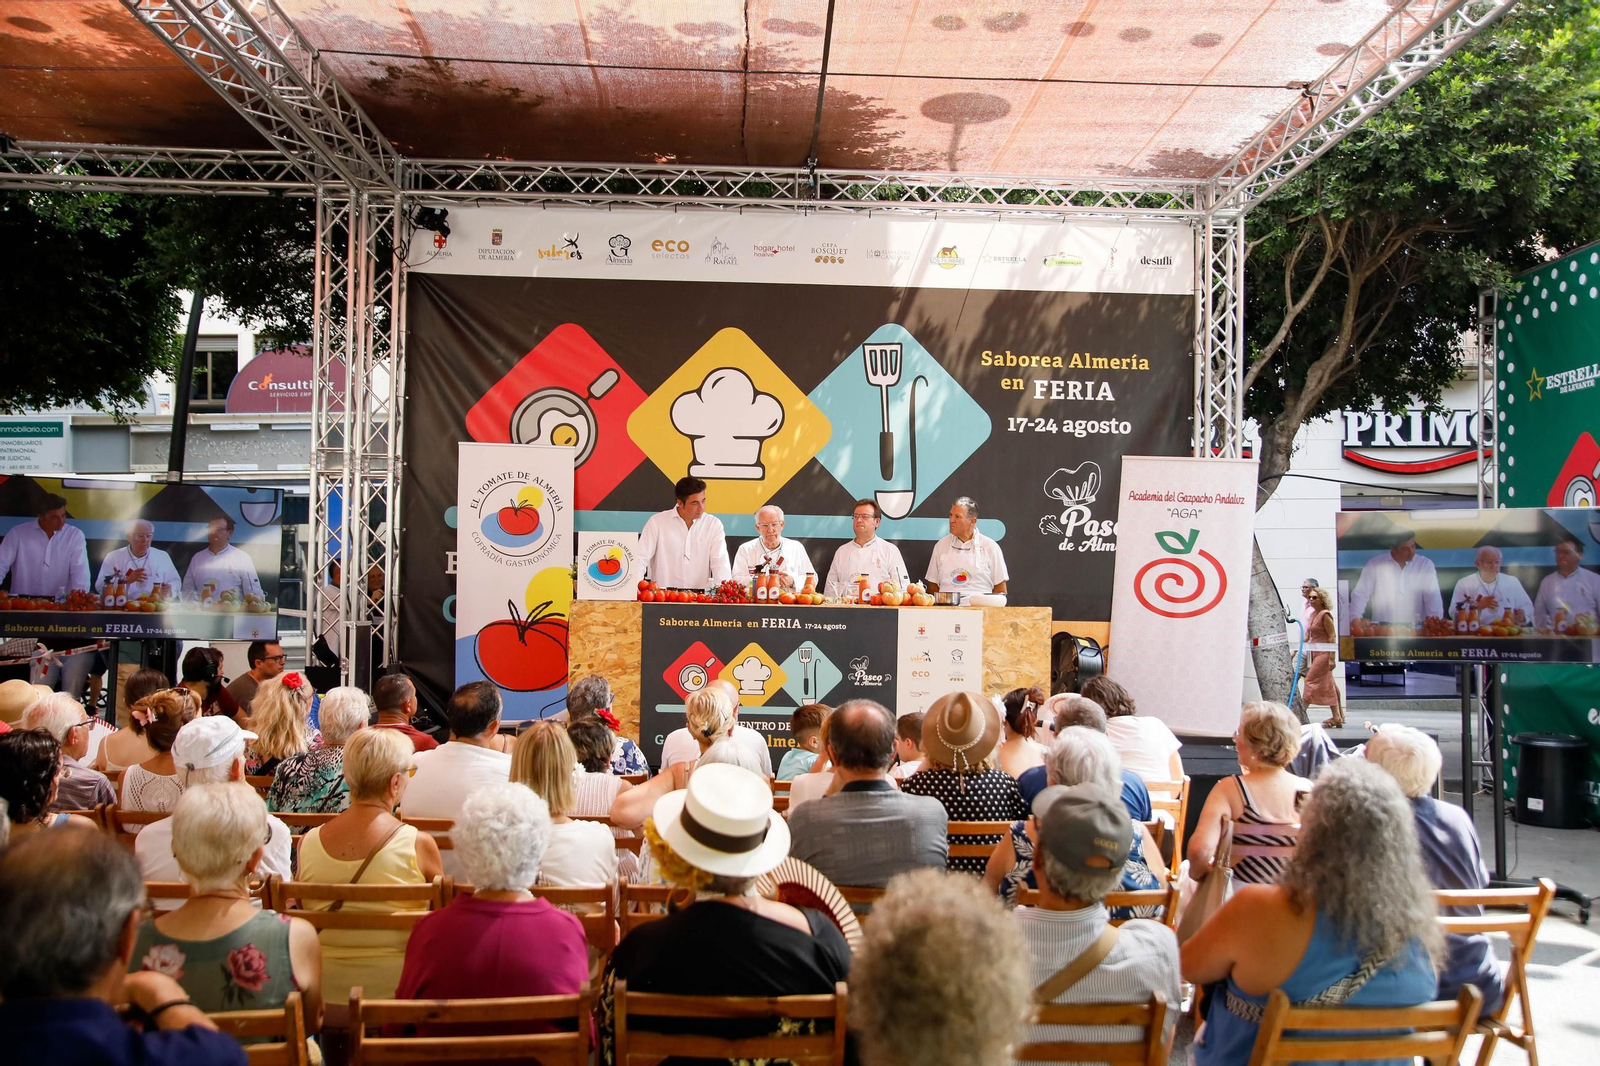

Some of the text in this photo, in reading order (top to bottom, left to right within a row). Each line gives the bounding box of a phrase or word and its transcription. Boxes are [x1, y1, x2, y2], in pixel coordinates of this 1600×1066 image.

[651, 239, 690, 252] eco
[753, 244, 795, 252] hogar hotel
[811, 247, 848, 255] BOSQUET
[651, 252, 690, 260] selectos
[713, 257, 739, 265] RAFAEL
[981, 350, 1150, 371] Saborea Almería
[1546, 363, 1600, 390] ESTRELL
[1000, 377, 1116, 401] en FERIA
[1007, 417, 1132, 438] 17-24 agosto
[470, 471, 564, 512] EL TOMATE DE ALMERÍA
[1128, 490, 1245, 505] Academia del Gazpacho Andaluz
[471, 531, 503, 565] COFRADÍA
[505, 533, 562, 567] GASTRONÓMICA
[586, 540, 606, 553] TOMATE
[1058, 535, 1117, 552] de Alm
[4, 624, 45, 632] Saborea
[47, 624, 87, 633] Almería
[105, 624, 144, 633] FERIA
[659, 617, 700, 627] Saborea
[702, 617, 742, 627] Almería
[761, 617, 802, 629] FERIA
[823, 622, 847, 631] agosto
[1369, 649, 1405, 657] Saborea
[1406, 649, 1443, 658] Almería
[1460, 648, 1498, 658] FERIA
[1518, 652, 1542, 660] agosto
[855, 670, 883, 681] Paseo
[777, 721, 791, 731] DE
[1093, 837, 1119, 850] GUCCI
